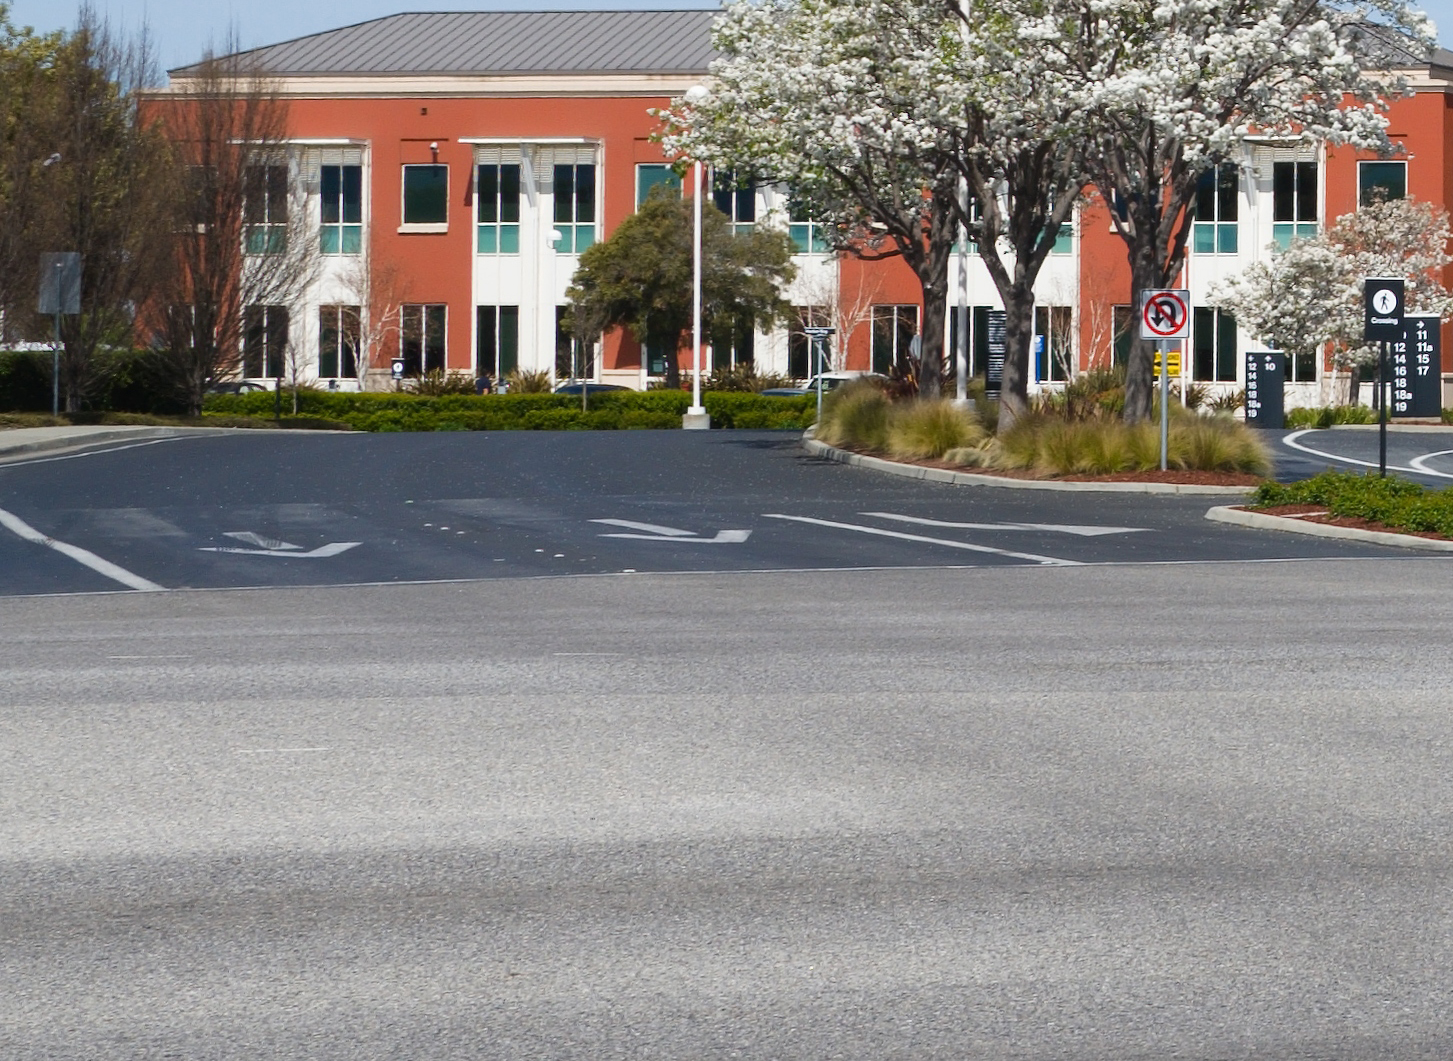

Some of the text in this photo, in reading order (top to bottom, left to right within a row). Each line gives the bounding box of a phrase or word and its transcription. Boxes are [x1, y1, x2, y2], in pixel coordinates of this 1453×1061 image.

[1416, 330, 1428, 340] 11
[1393, 342, 1406, 352] 12
[1416, 342, 1433, 352] 11a
[1393, 354, 1407, 364] 14
[1416, 354, 1430, 364] 15
[1247, 362, 1257, 371] 12
[1264, 362, 1276, 371] 10
[1394, 366, 1407, 376] 16
[1416, 366, 1430, 376] 17
[1394, 378, 1407, 388] 18
[1394, 402, 1407, 412] 19
